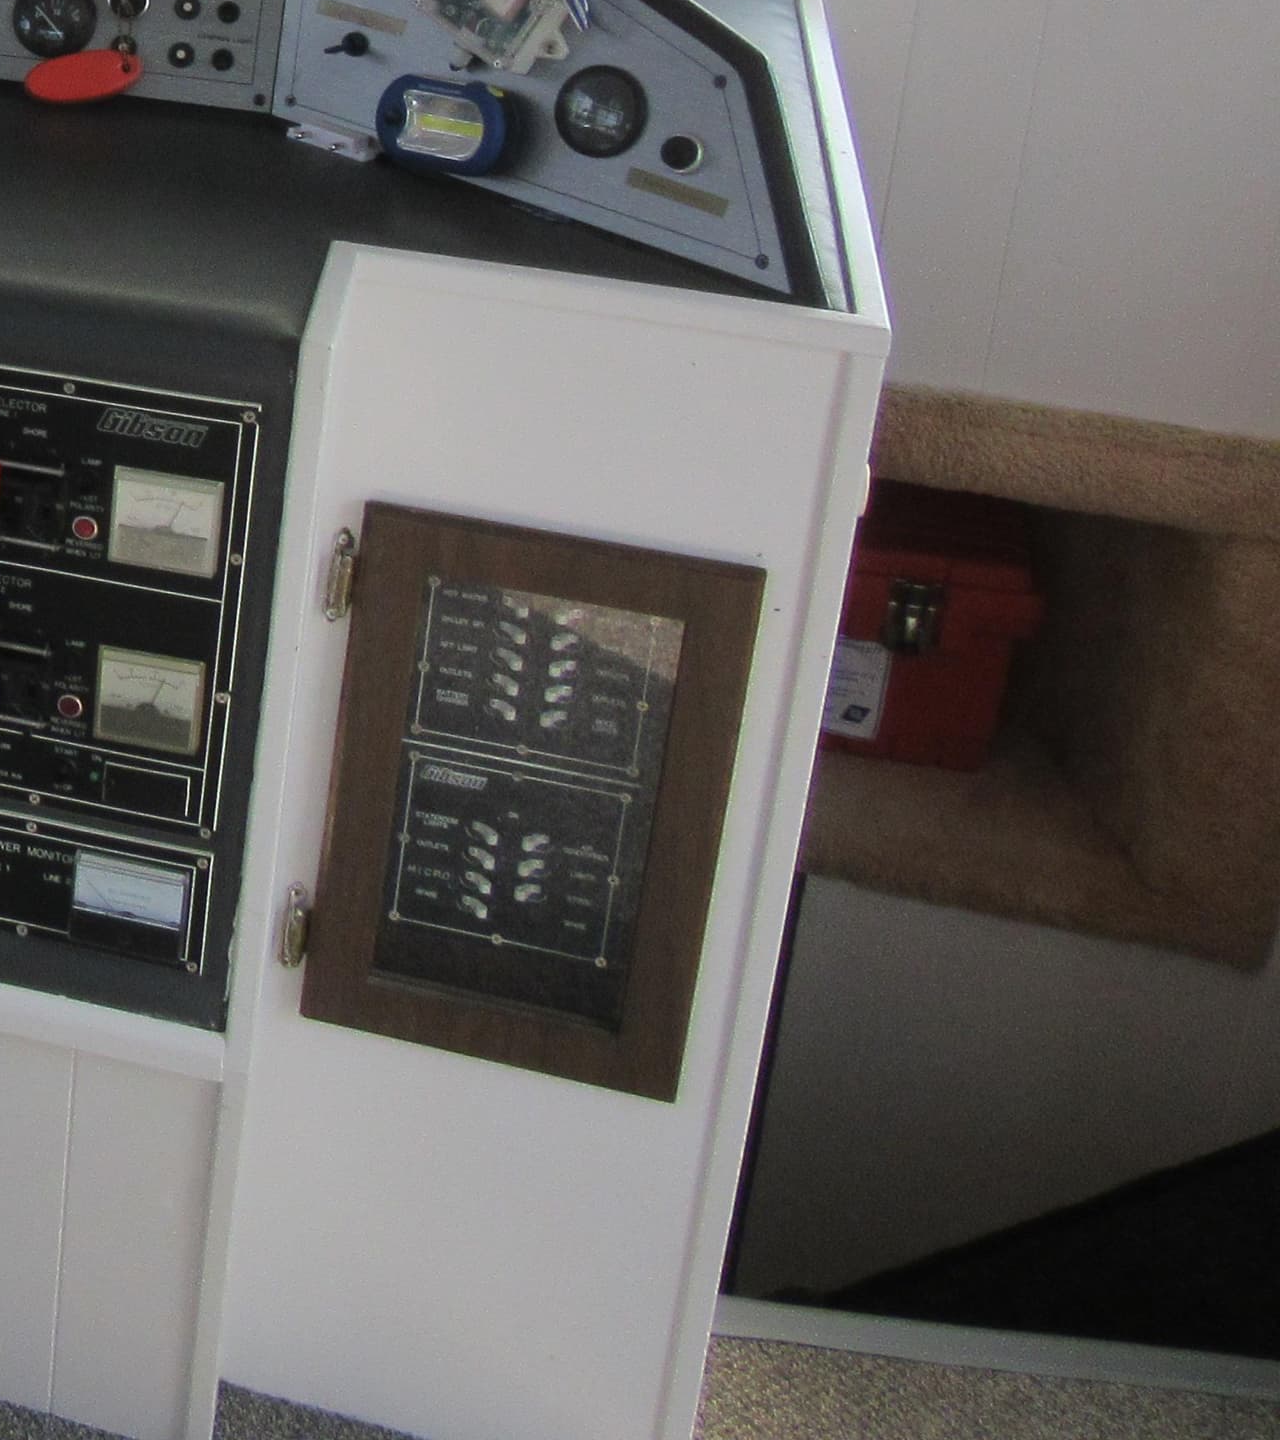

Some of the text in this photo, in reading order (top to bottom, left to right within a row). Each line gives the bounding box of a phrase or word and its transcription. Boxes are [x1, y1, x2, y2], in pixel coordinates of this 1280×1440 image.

[22, 427, 47, 438] SHORE
[96, 407, 209, 448] Gibson
[81, 457, 102, 466] LAMP
[8, 601, 32, 612] SHORE
[65, 639, 86, 648] LAMP
[54, 746, 79, 756] START
[419, 764, 488, 791] Gibson
[42, 872, 61, 884] LINE
[407, 864, 450, 881] MICRO
